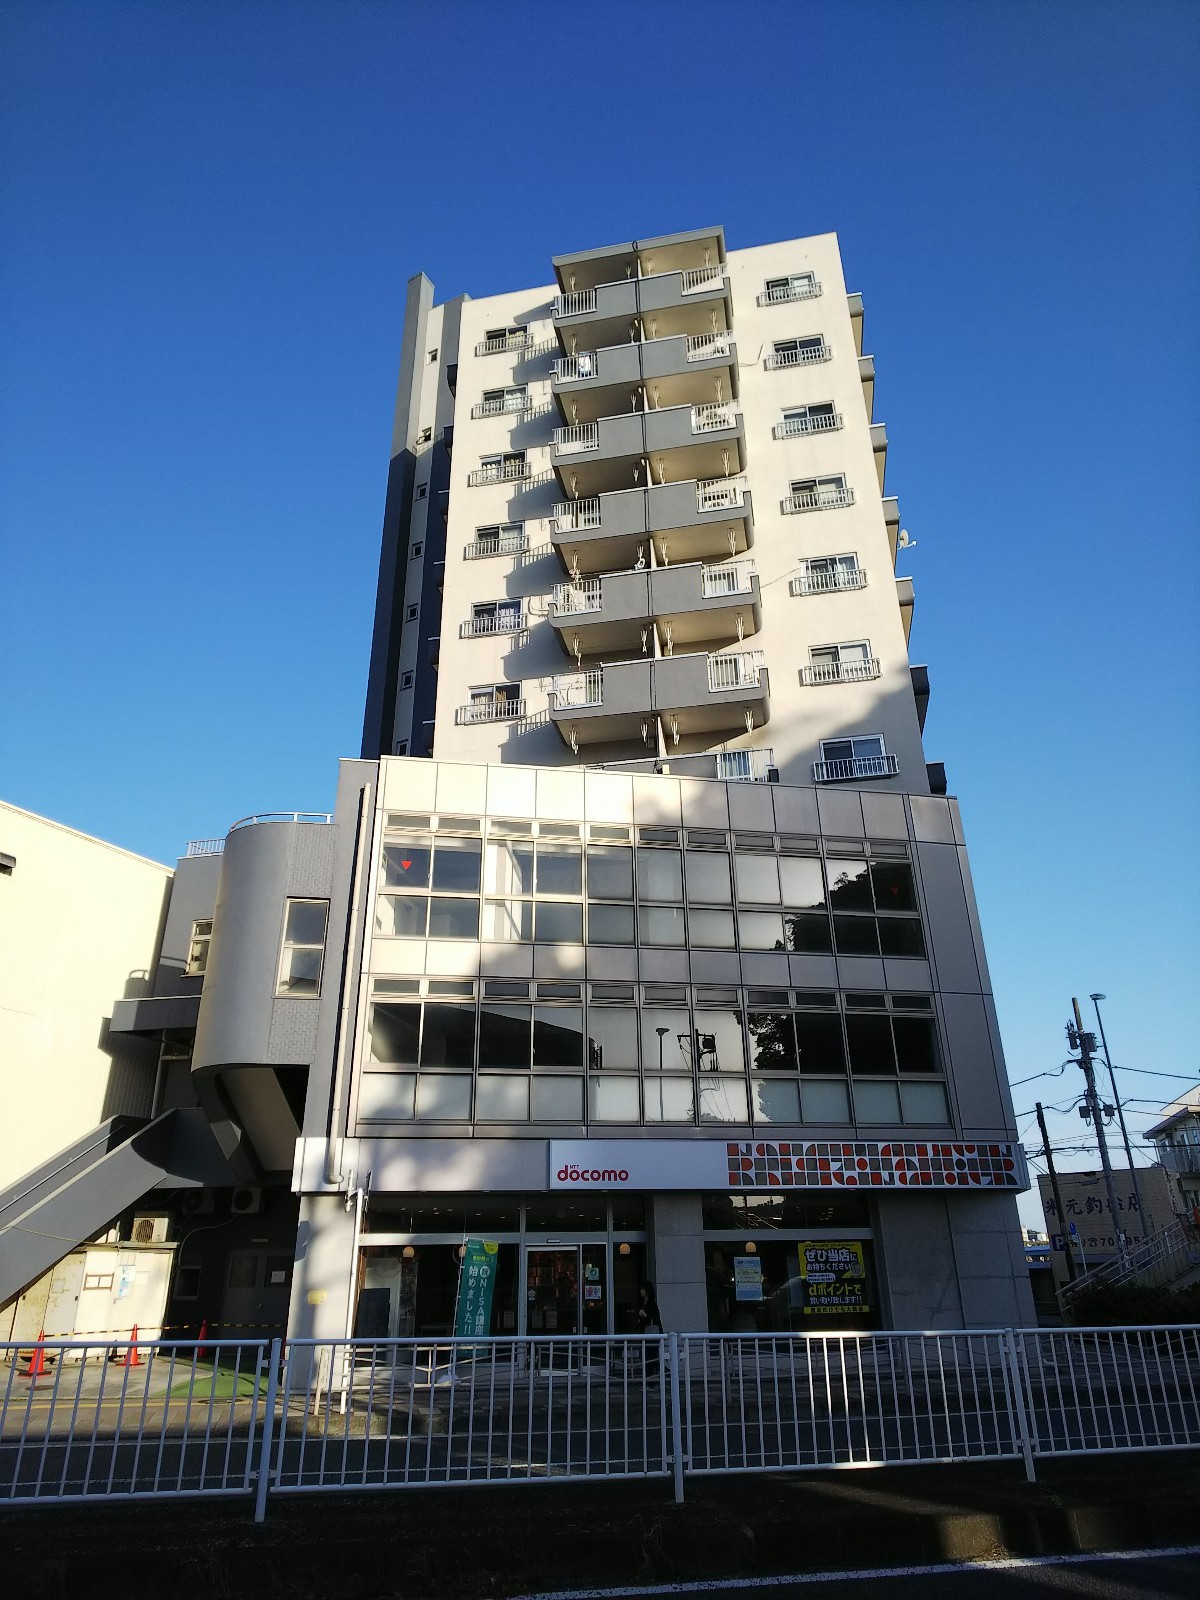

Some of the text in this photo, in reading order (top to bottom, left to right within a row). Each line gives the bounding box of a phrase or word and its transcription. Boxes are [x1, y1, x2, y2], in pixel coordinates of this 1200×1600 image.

[557, 1165, 629, 1182] docomo
[805, 1248, 858, 1262] ぜひ当店に
[806, 1262, 851, 1271] お持ちください
[808, 1283, 862, 1296] dポイントで
